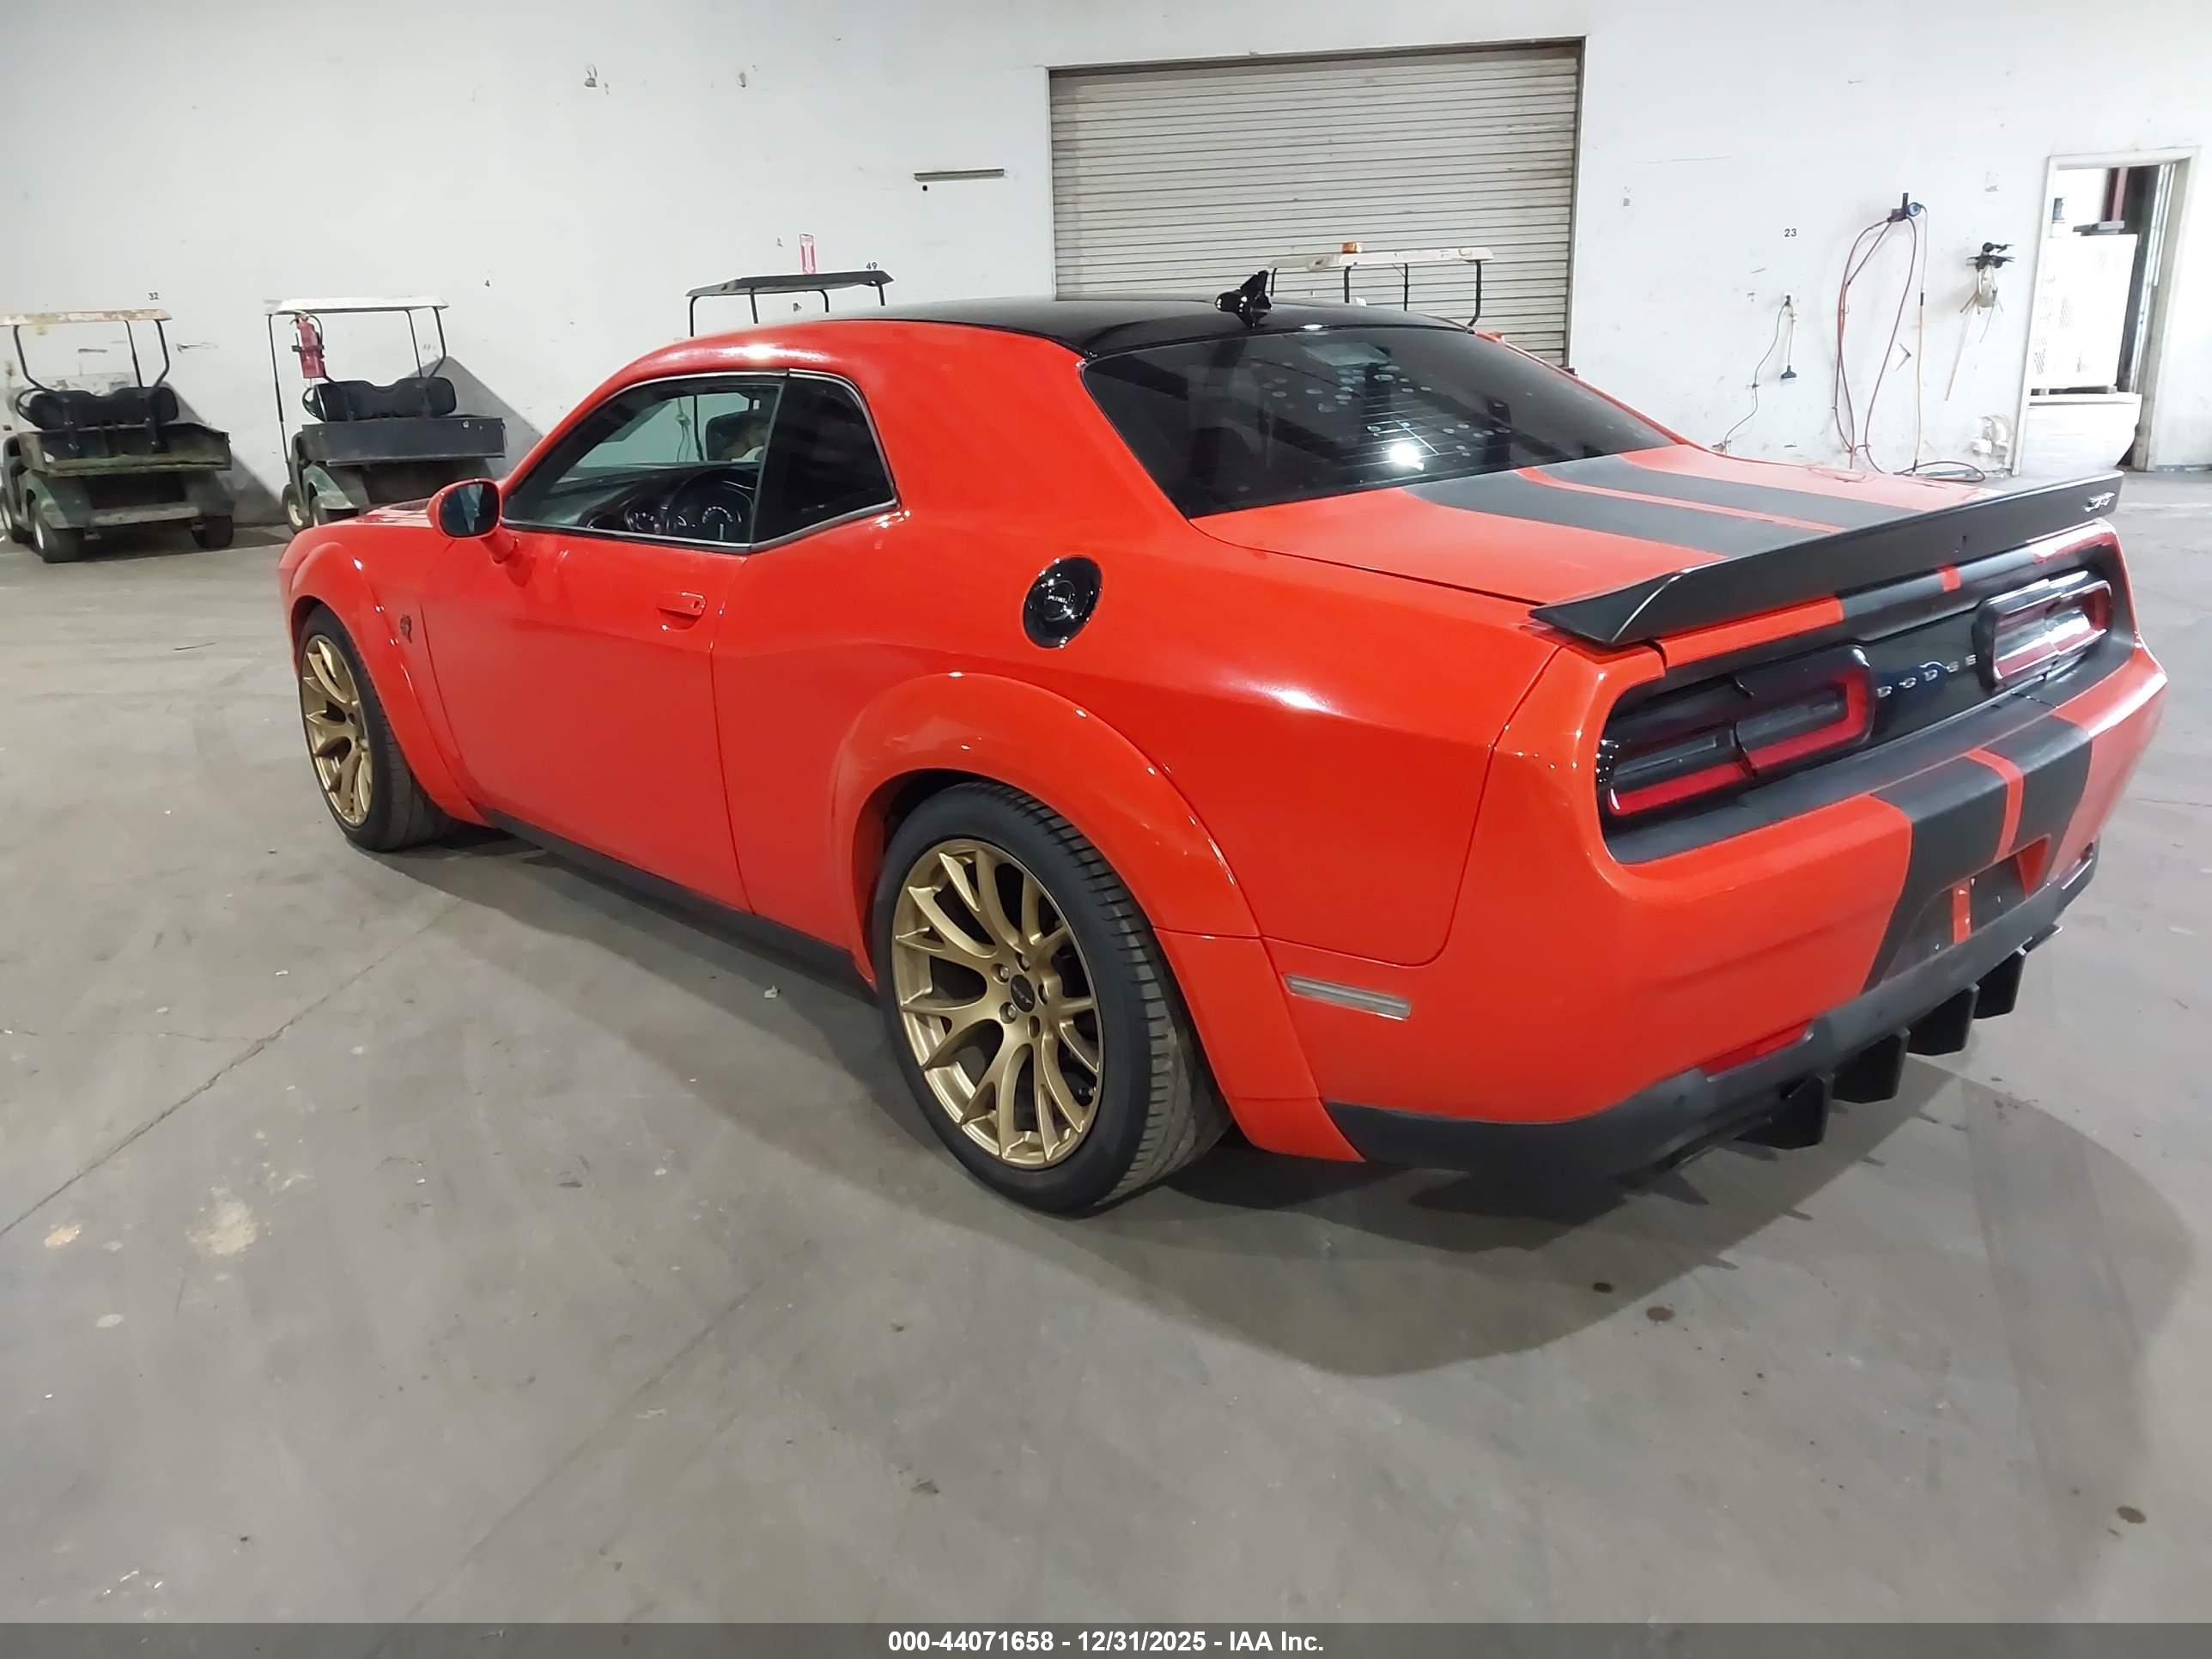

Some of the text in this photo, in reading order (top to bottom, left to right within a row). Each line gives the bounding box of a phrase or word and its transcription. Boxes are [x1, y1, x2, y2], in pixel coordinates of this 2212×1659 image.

[1784, 228, 1797, 238] 23
[866, 261, 878, 270] 49
[148, 291, 160, 301] 32
[1876, 653, 1978, 698] DODGE
